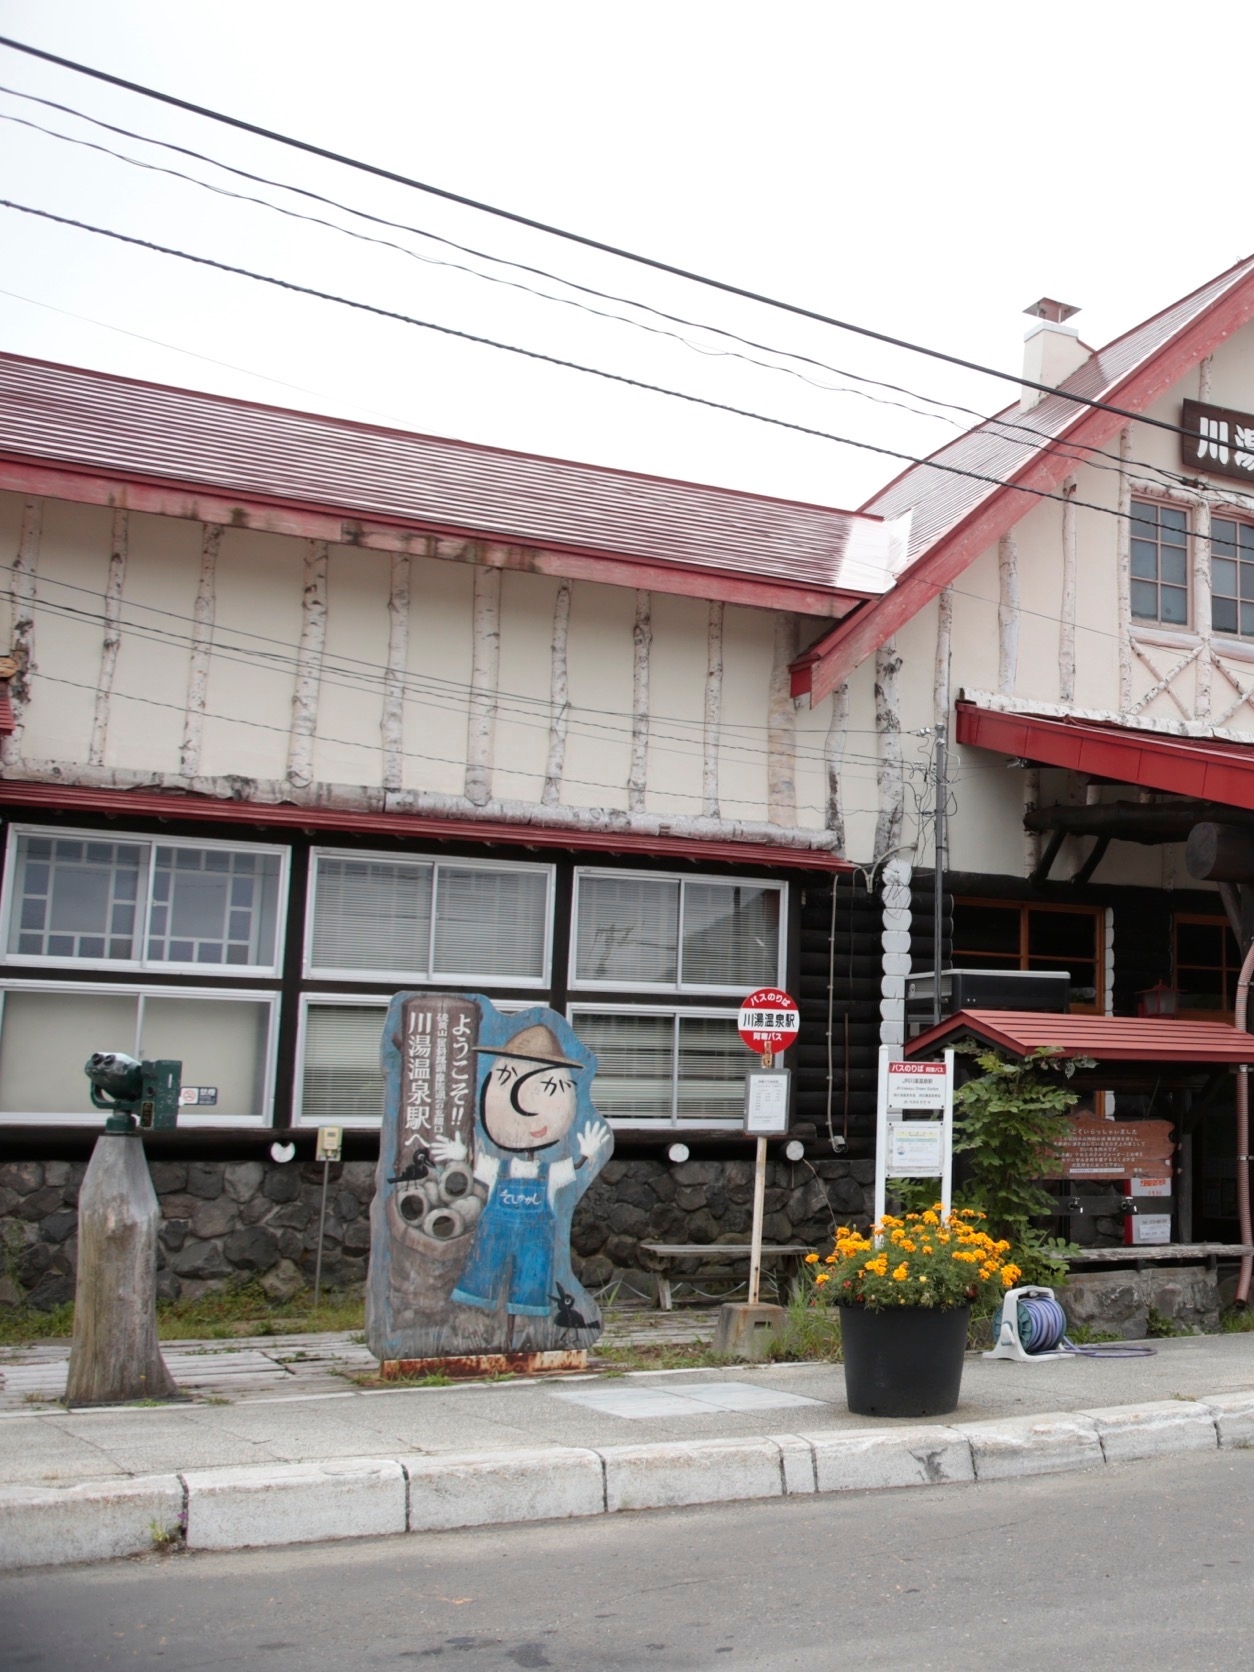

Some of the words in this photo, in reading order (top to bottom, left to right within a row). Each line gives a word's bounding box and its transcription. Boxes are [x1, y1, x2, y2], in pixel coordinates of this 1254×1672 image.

[750, 993, 791, 1007] バスのりば
[743, 1012, 795, 1028] 川湯温泉駅
[753, 1032, 782, 1041] 阿寒バス
[891, 1064, 925, 1073] バスのりば
[404, 1011, 433, 1148] 川湯温泉駅へ
